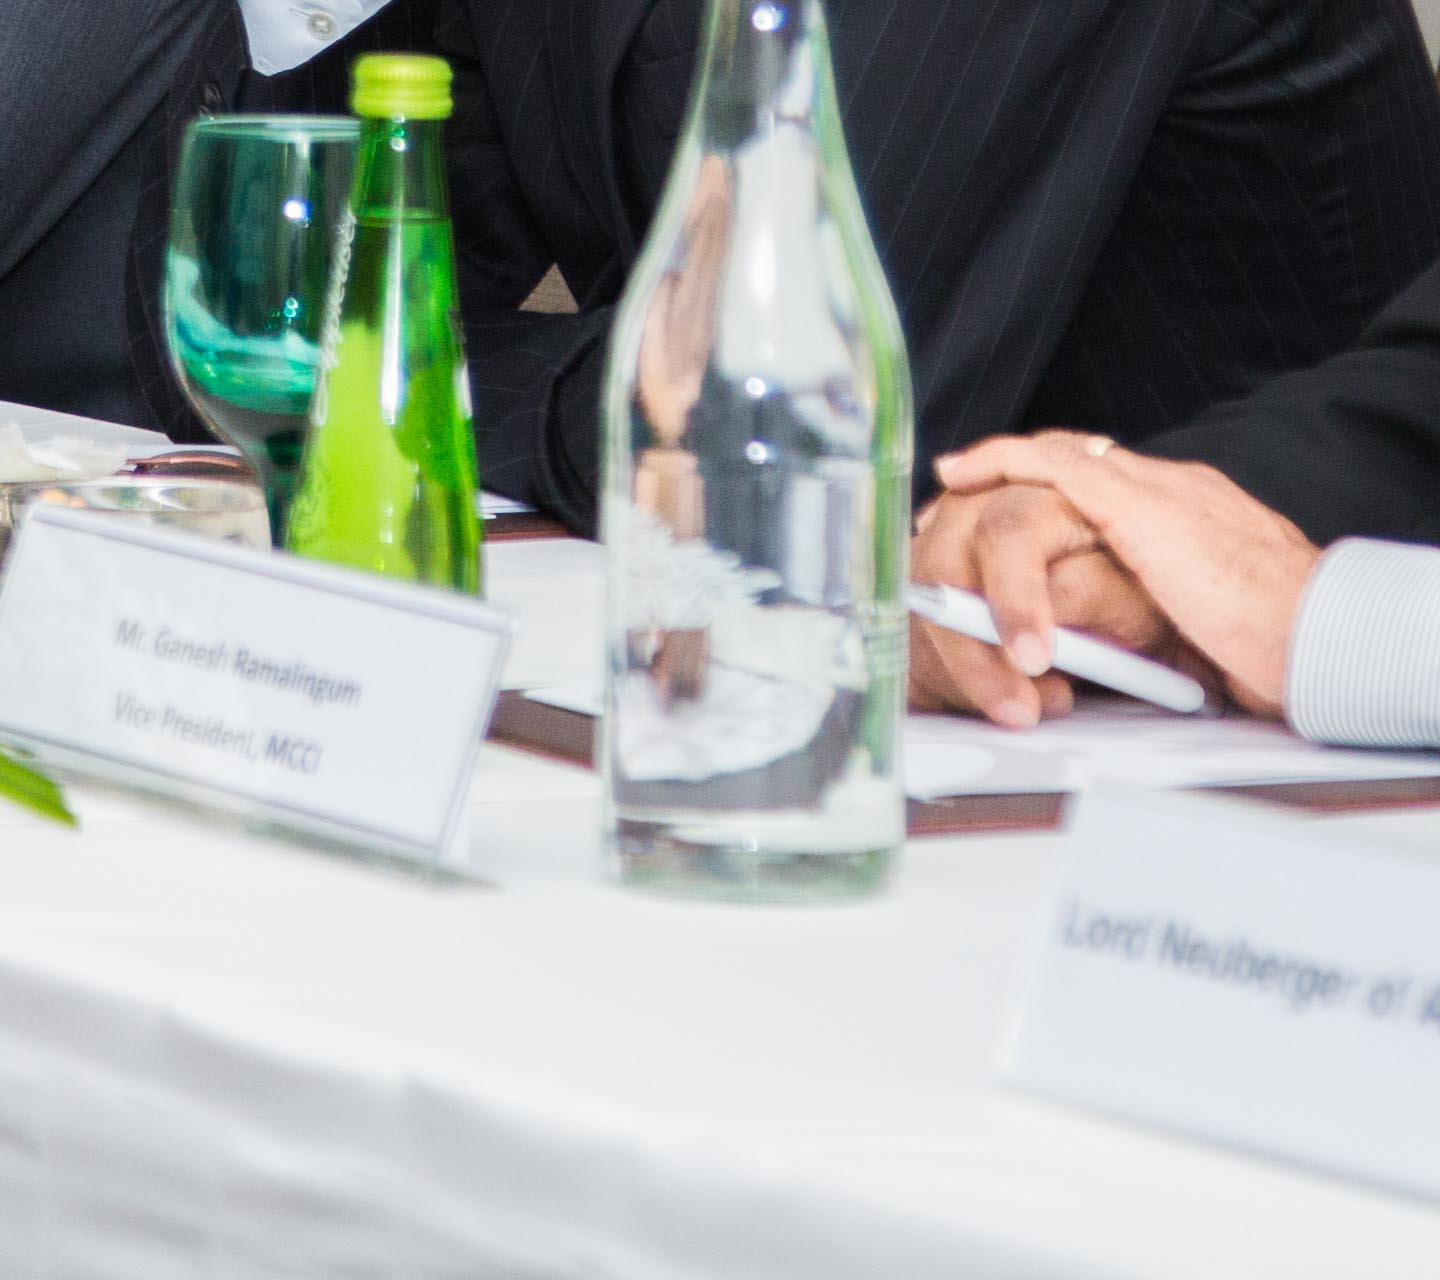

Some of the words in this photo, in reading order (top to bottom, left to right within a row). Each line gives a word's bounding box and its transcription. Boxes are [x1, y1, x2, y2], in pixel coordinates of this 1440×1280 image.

[113, 617, 149, 653] Mr.
[154, 629, 229, 671] Ganesh
[233, 649, 362, 707] Ramalingum
[113, 690, 157, 728] Vice
[1063, 899, 1157, 956] Lord
[1159, 919, 1357, 1011] Neuberger
[1369, 970, 1413, 1018] of
